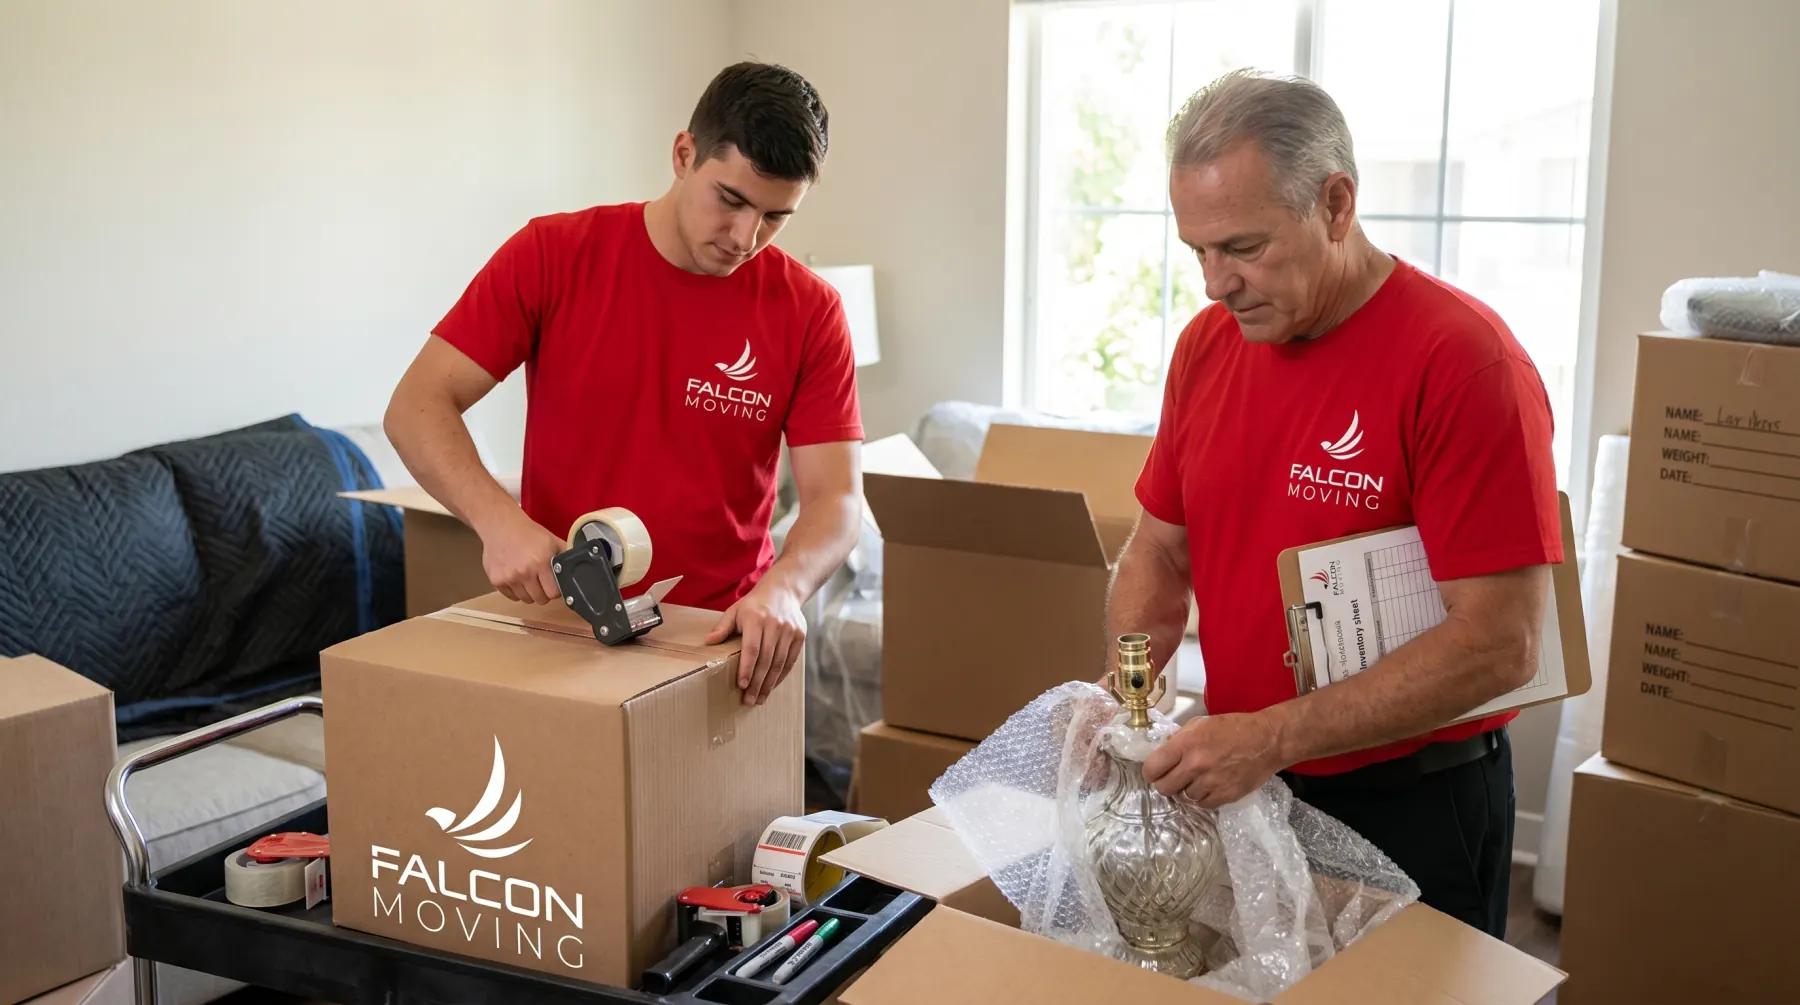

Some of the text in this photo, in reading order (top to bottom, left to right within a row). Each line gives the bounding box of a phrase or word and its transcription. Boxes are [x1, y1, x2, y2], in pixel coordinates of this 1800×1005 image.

[687, 378, 772, 408] FALCON
[685, 394, 767, 421] MOVING
[1665, 406, 1702, 423] NAME:
[1664, 427, 1700, 443] NAME:
[1661, 448, 1709, 465] WEIGHT:
[1290, 463, 1384, 493] FALCON
[1660, 468, 1692, 483] DATE:
[1287, 482, 1380, 510] MOVING
[1329, 561, 1339, 595] FALCON
[1350, 598, 1368, 670] Inventory sheet
[1646, 623, 1684, 640] NAME:
[1644, 642, 1682, 660] NAME:
[1642, 662, 1690, 683] WEIGHT:
[1640, 682, 1673, 699] DATE:
[371, 844, 583, 929] FALCON
[373, 886, 583, 969] MOVING
